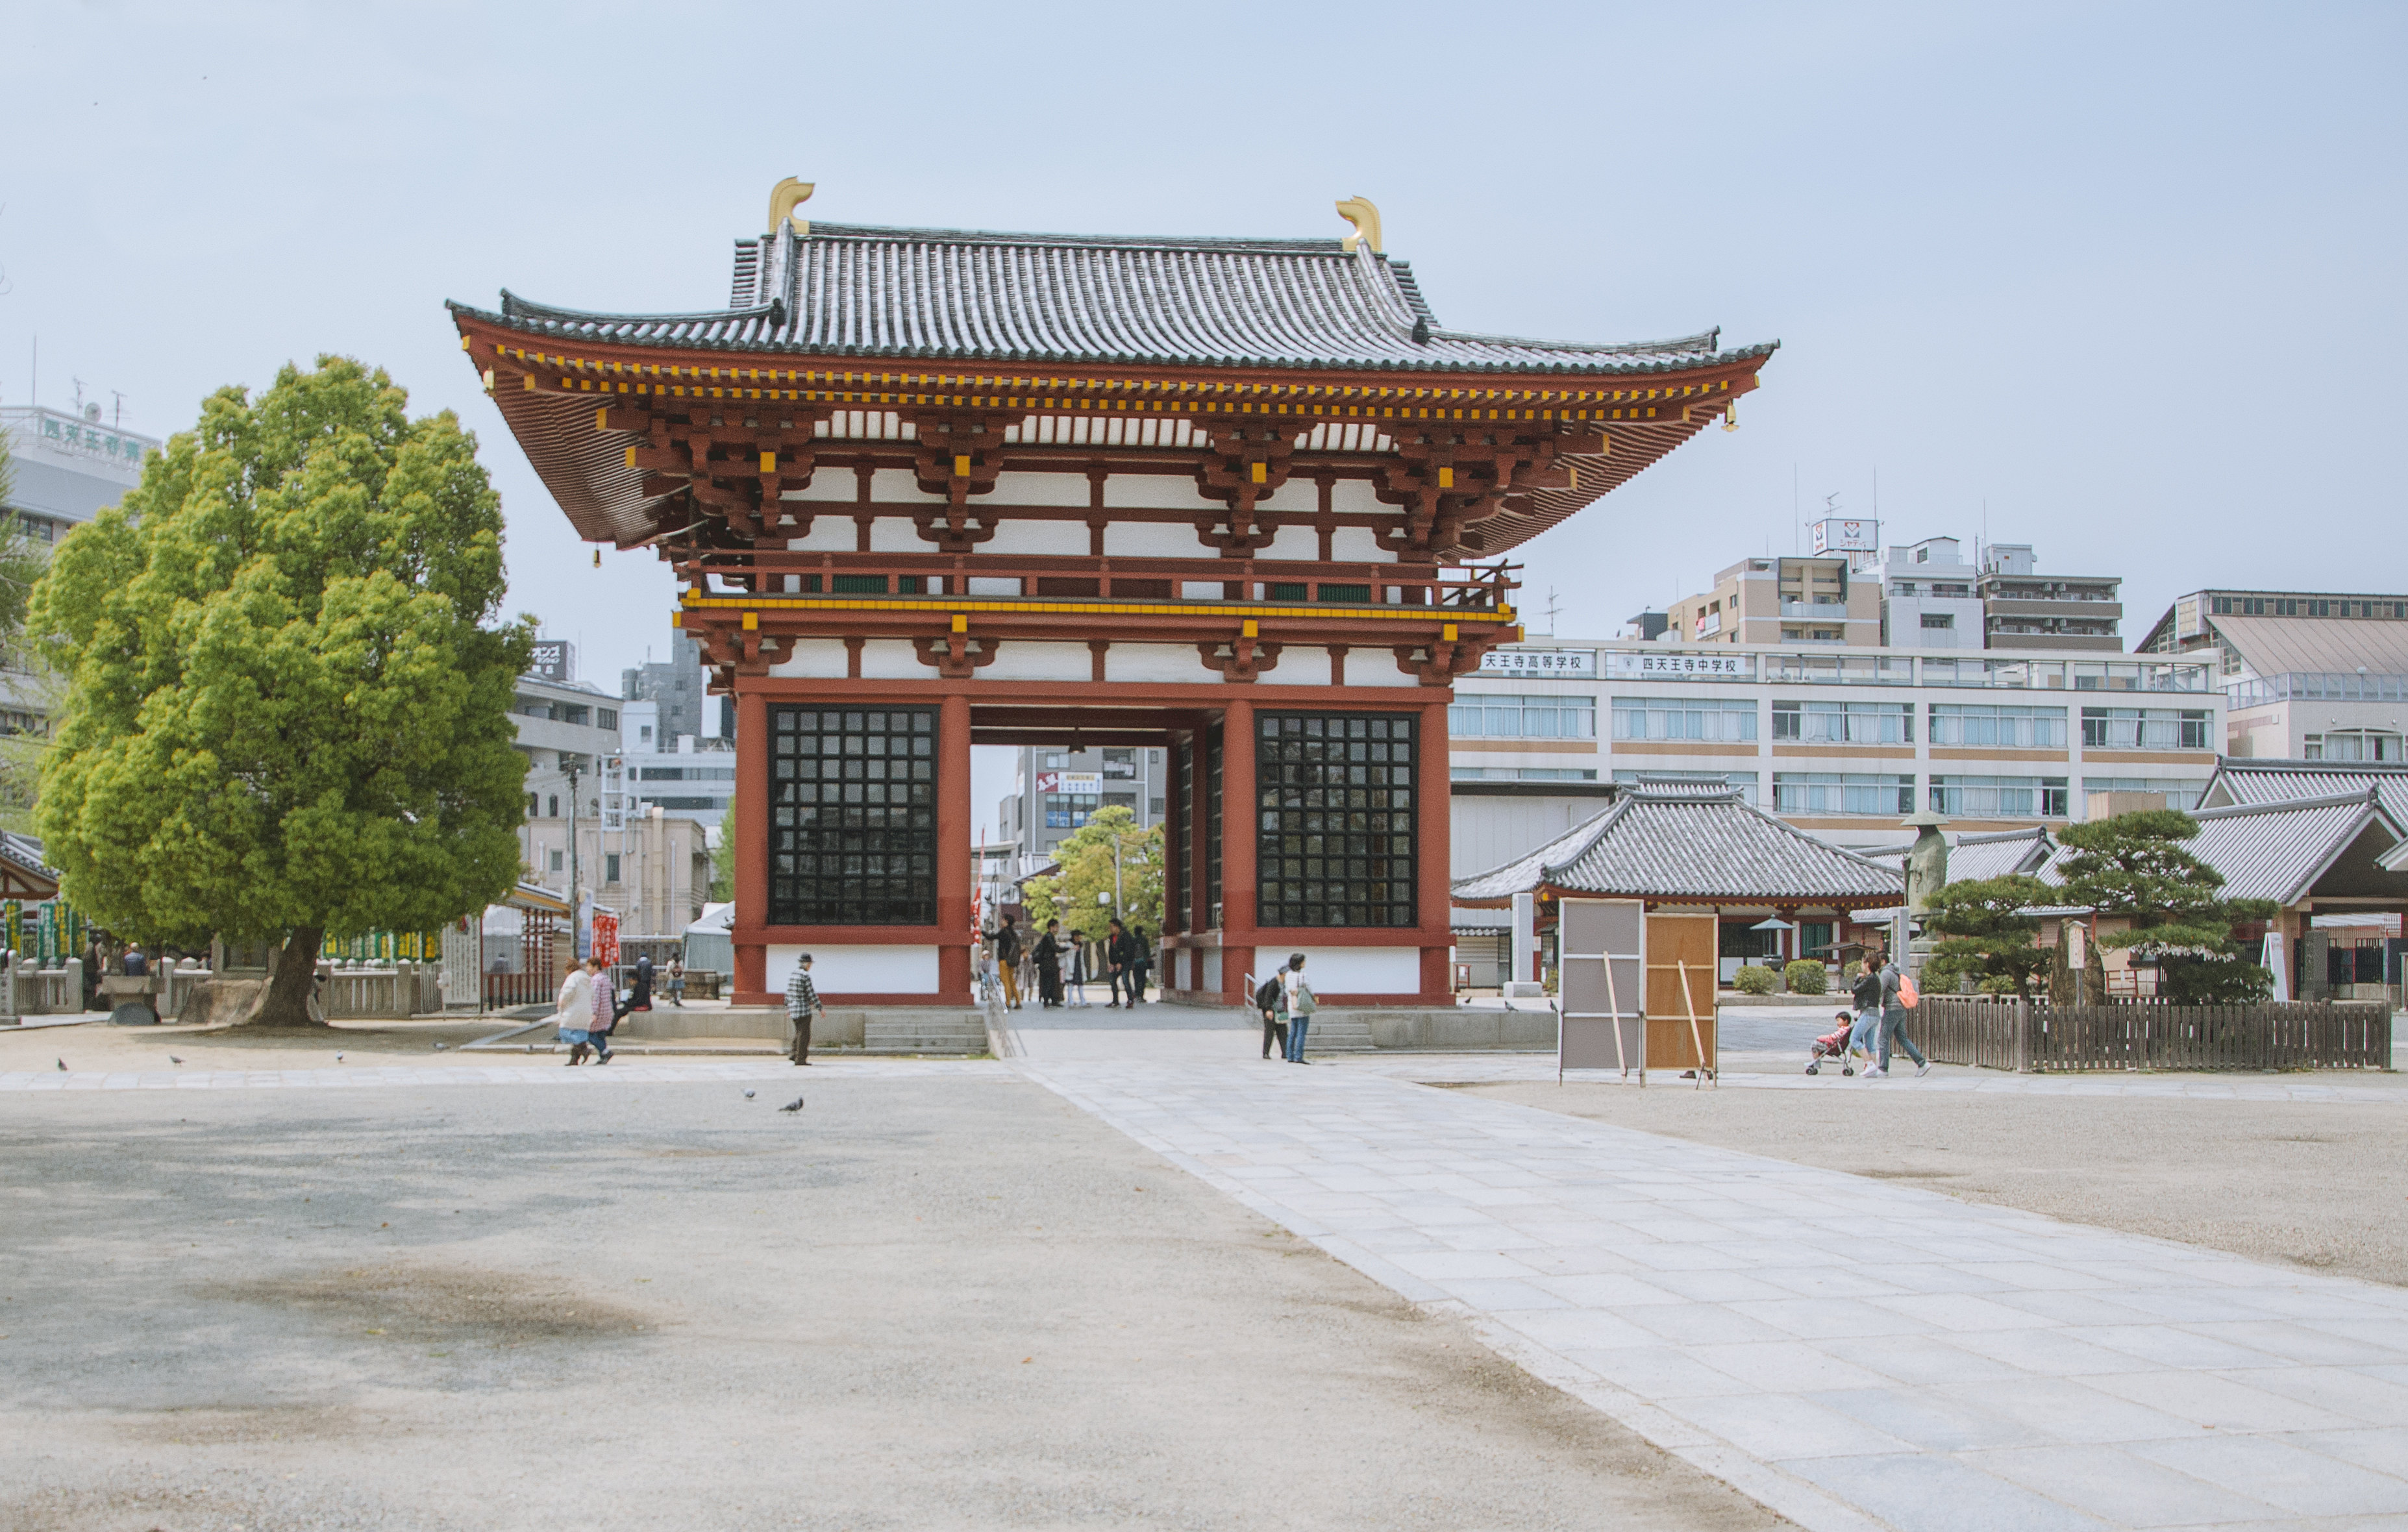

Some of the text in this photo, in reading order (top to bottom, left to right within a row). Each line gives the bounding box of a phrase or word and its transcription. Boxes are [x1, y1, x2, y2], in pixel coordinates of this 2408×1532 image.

[1485, 654, 1581, 669] 天王寺高等学校
[1643, 658, 1736, 672] 四天王寺中学校
